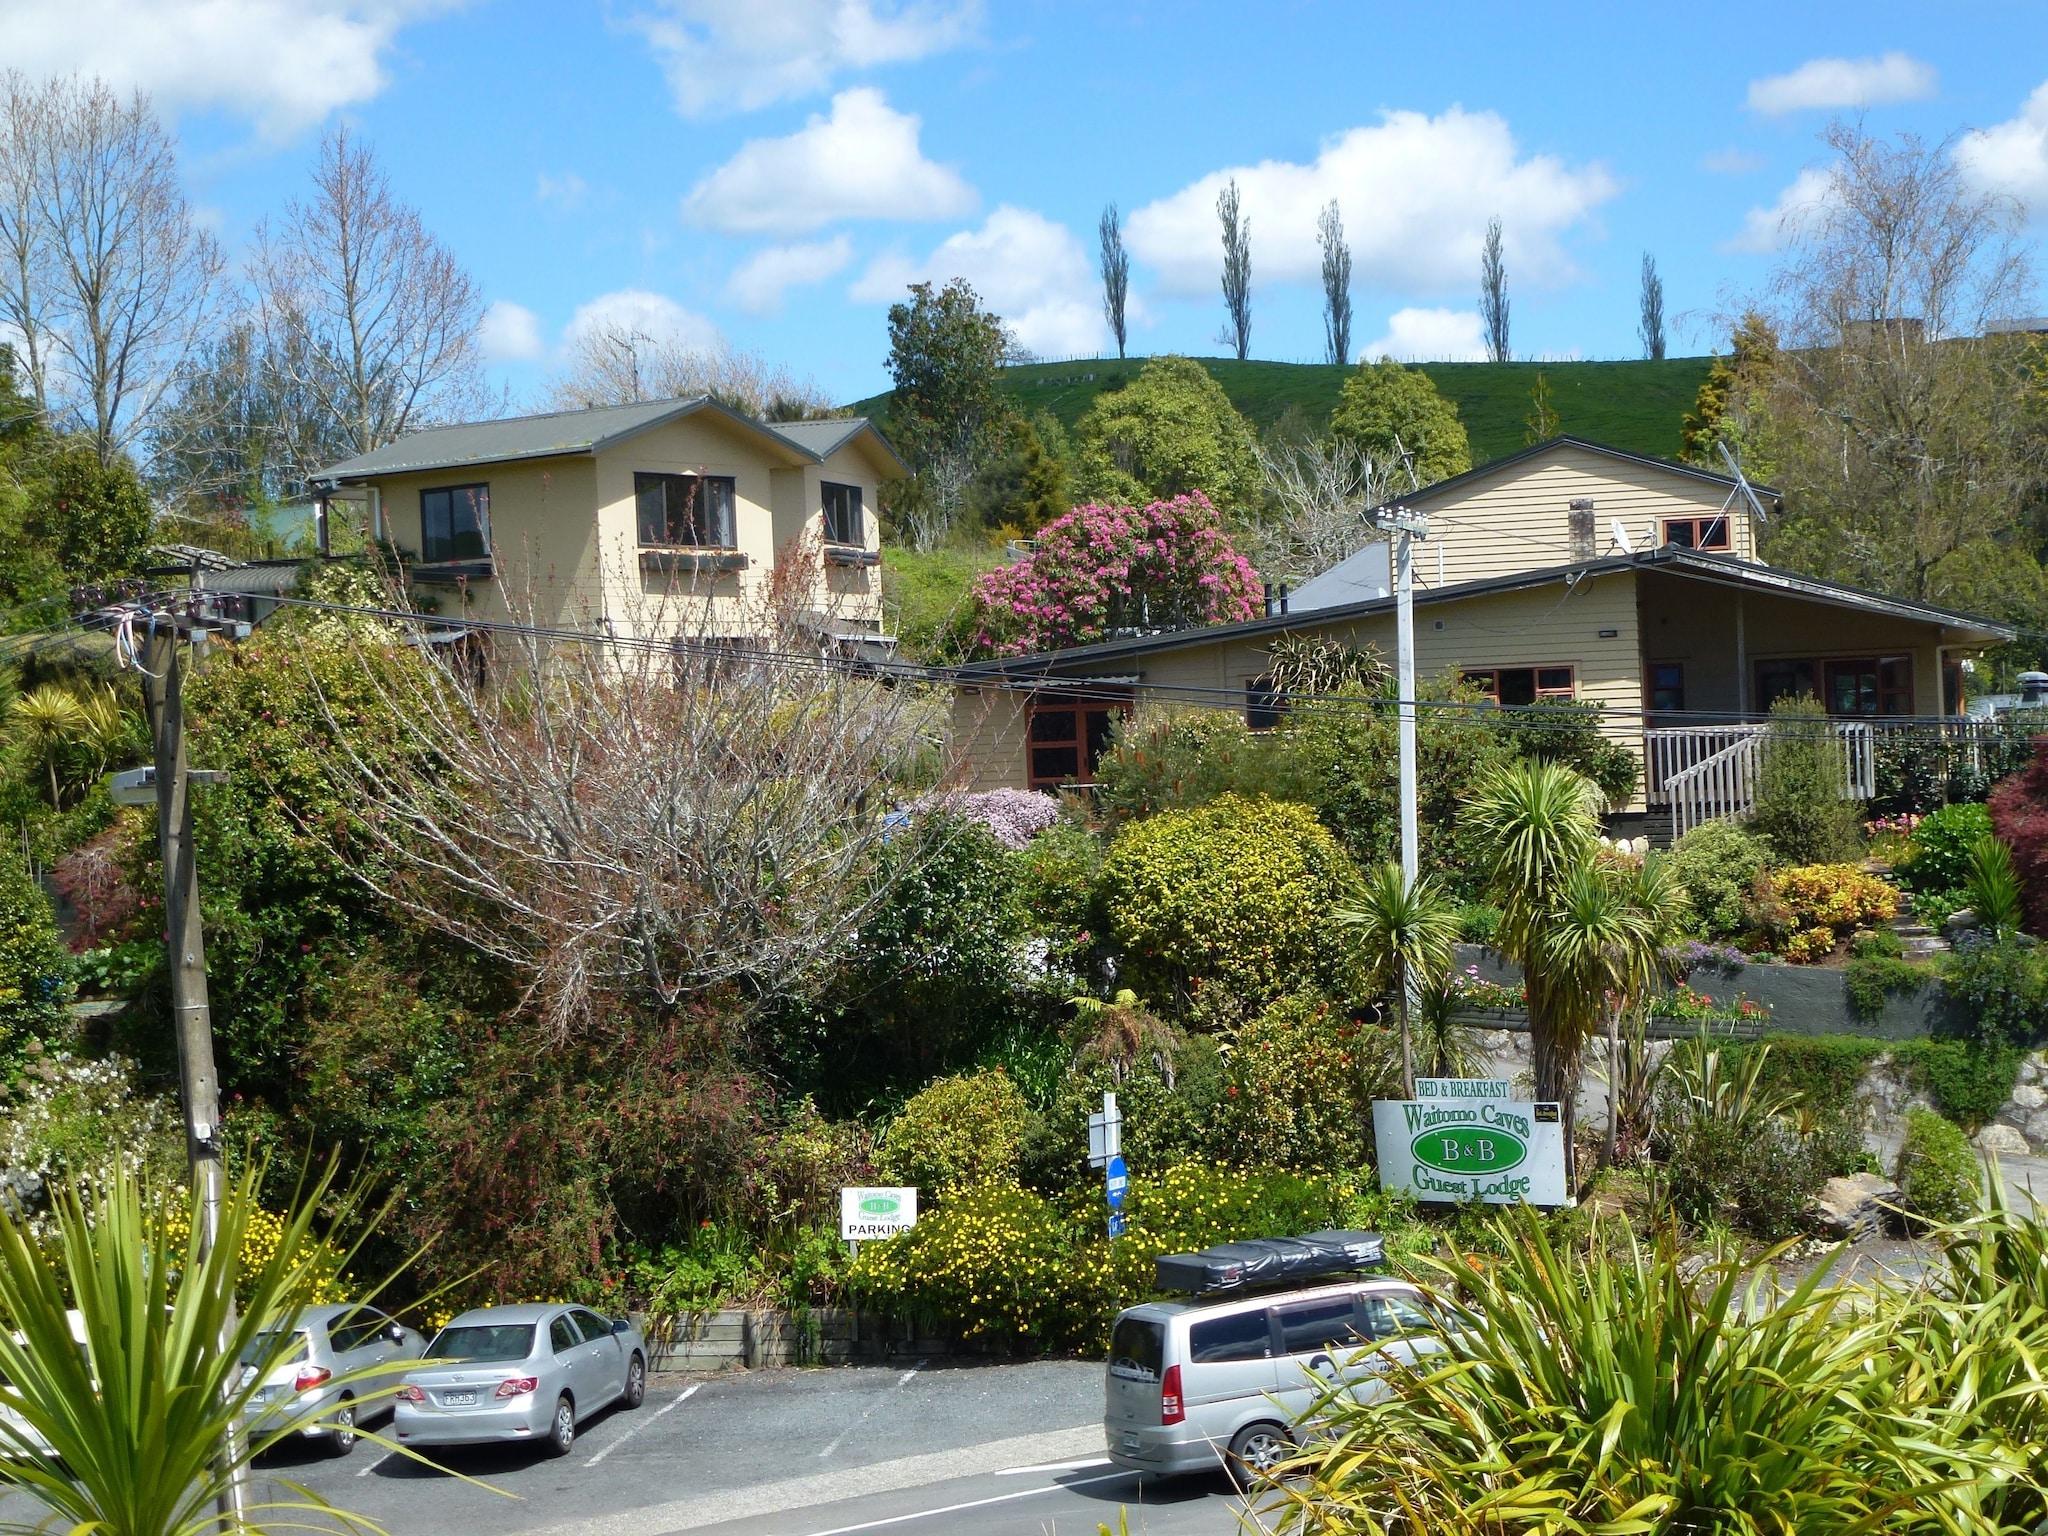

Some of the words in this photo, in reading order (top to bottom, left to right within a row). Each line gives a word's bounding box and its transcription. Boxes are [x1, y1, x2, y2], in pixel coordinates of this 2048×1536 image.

[1418, 1081, 1437, 1097] BED
[1441, 1085, 1448, 1097] &
[1450, 1081, 1508, 1098] BREAKFAST
[1402, 1104, 1477, 1135] Waitomo
[1481, 1104, 1530, 1139] Caves
[1441, 1139, 1460, 1161] B
[1463, 1144, 1474, 1157] &
[1477, 1139, 1495, 1161] B
[1412, 1164, 1467, 1194] Guest
[1471, 1174, 1531, 1200] Lodge
[849, 1224, 911, 1235] PARKING
